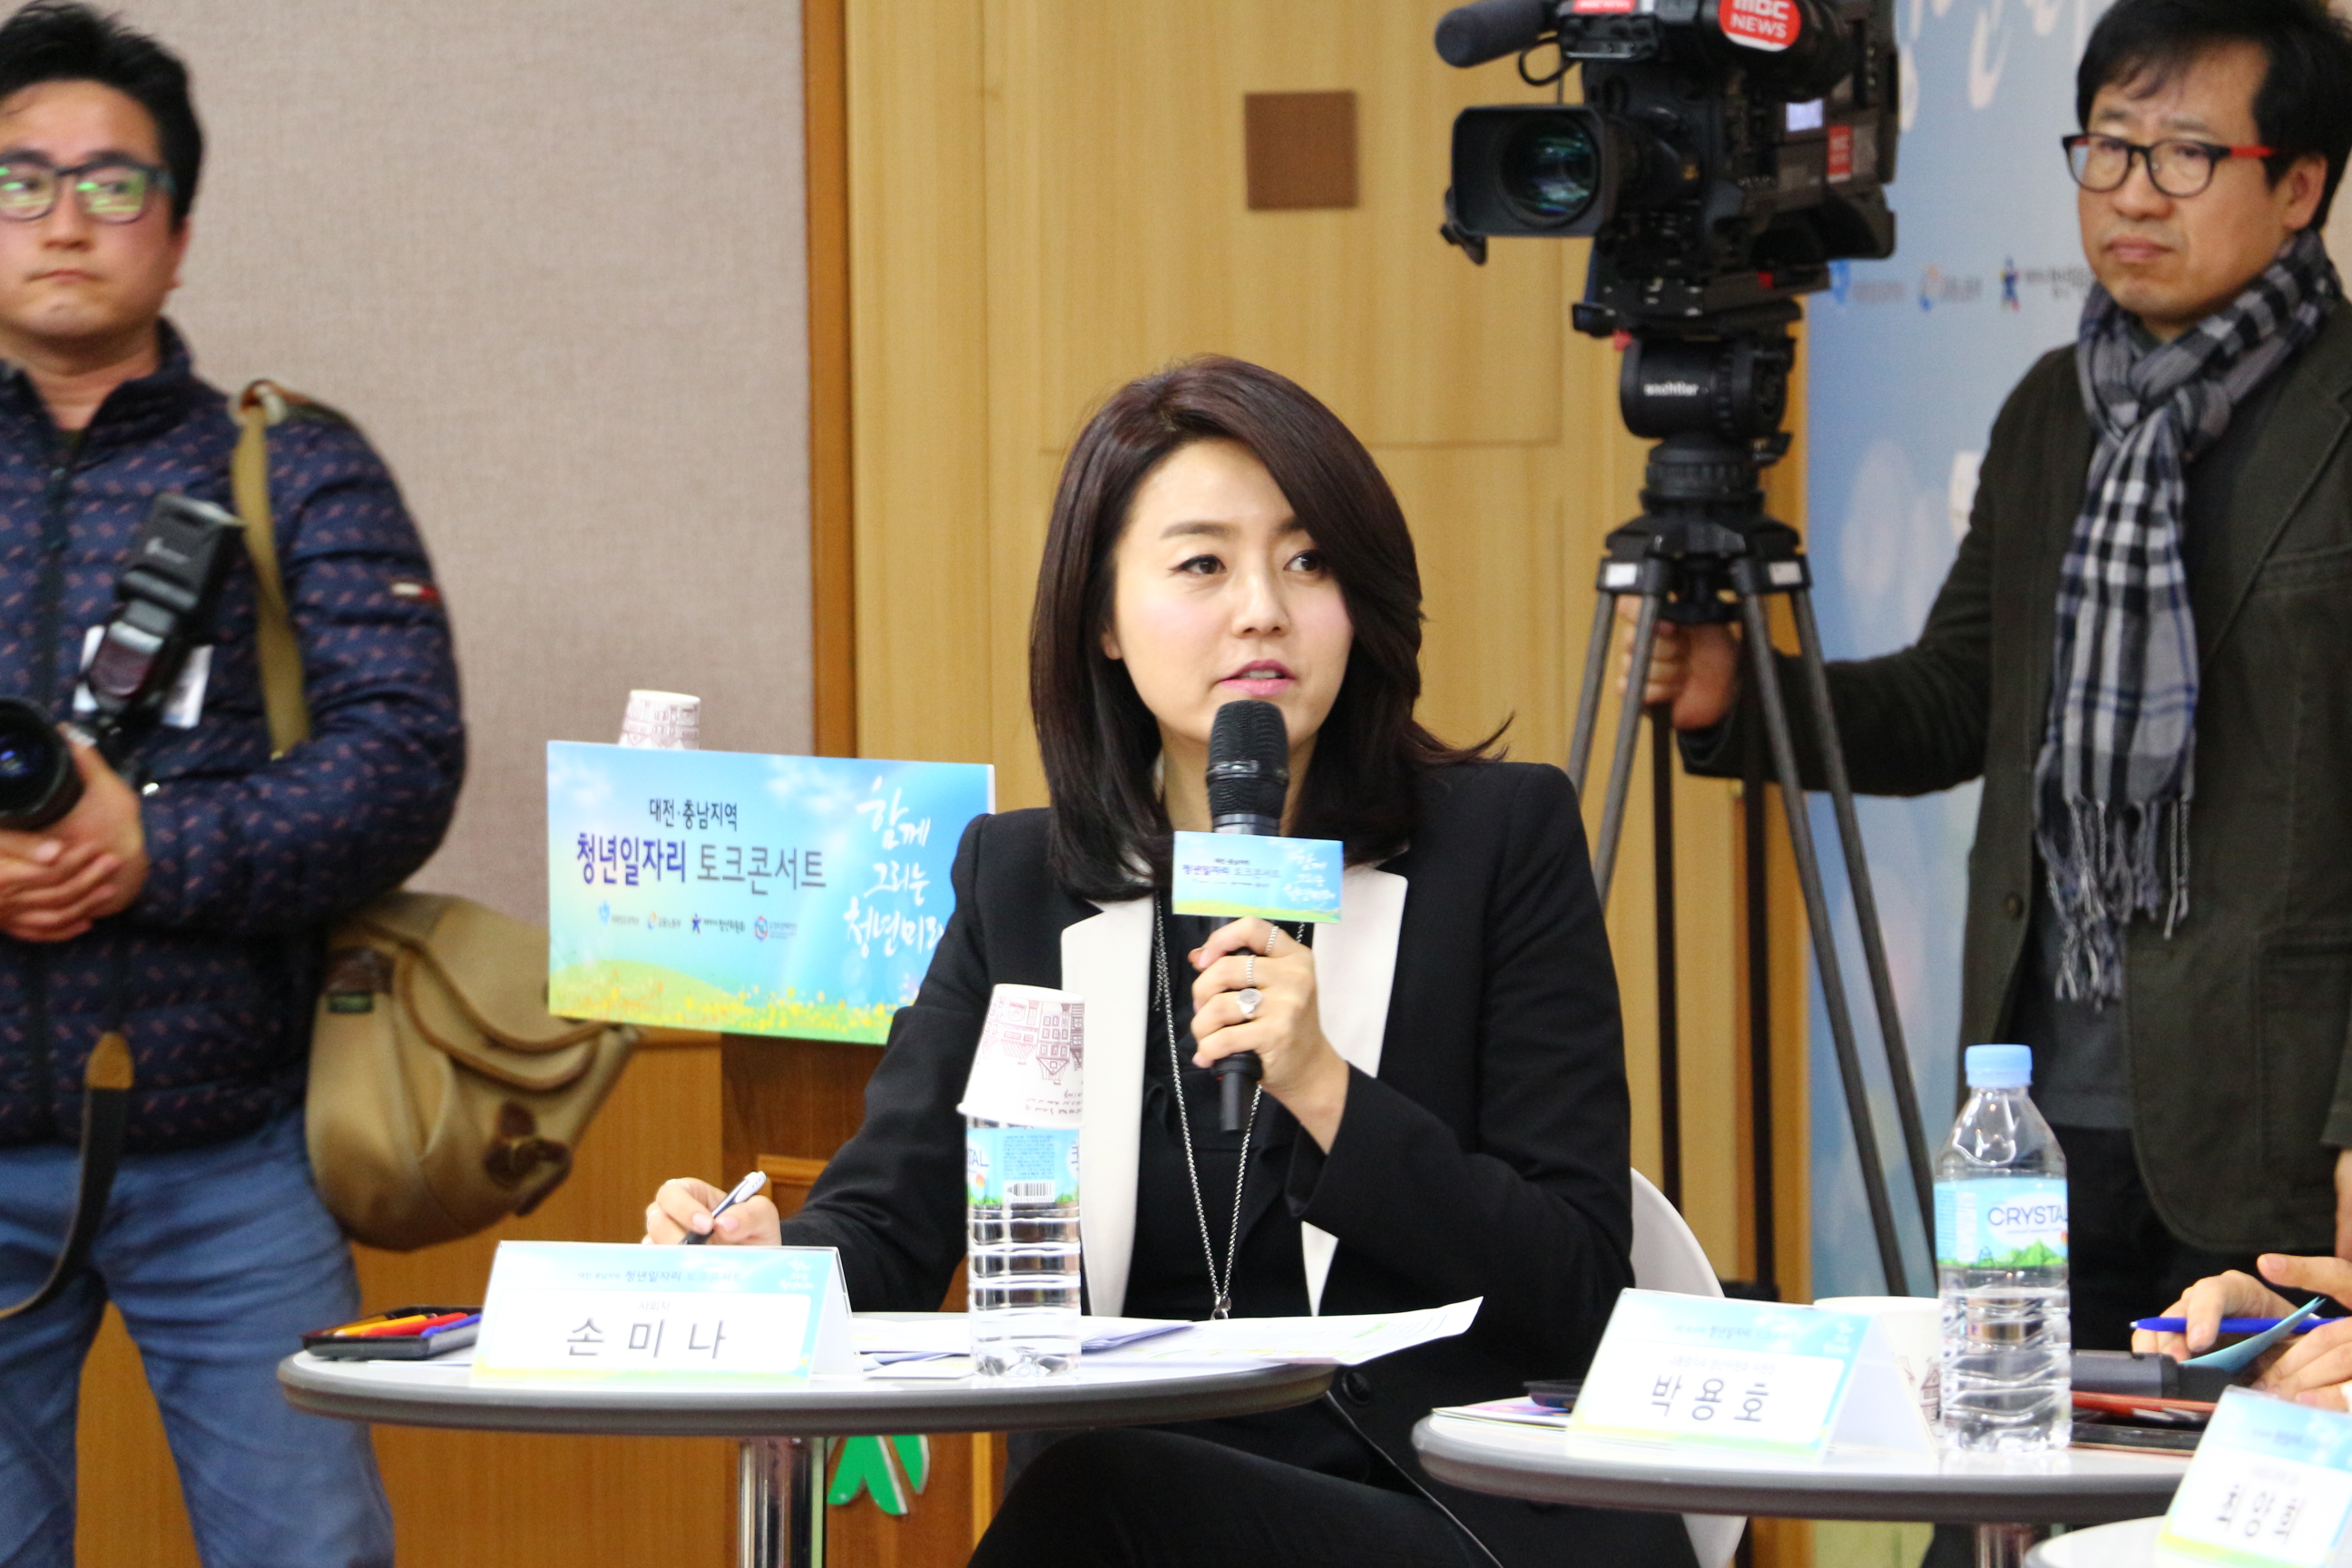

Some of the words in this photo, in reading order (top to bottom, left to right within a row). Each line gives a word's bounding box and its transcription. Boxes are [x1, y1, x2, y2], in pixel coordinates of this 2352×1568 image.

[1730, 14, 1788, 39] NEWS
[856, 776, 931, 850] 함께
[577, 832, 686, 886] 청년일자리
[697, 843, 827, 896] 토크콘서트
[864, 860, 930, 906] 그리는
[625, 1270, 681, 1282] 청년일자리
[638, 1299, 670, 1312] 사회자
